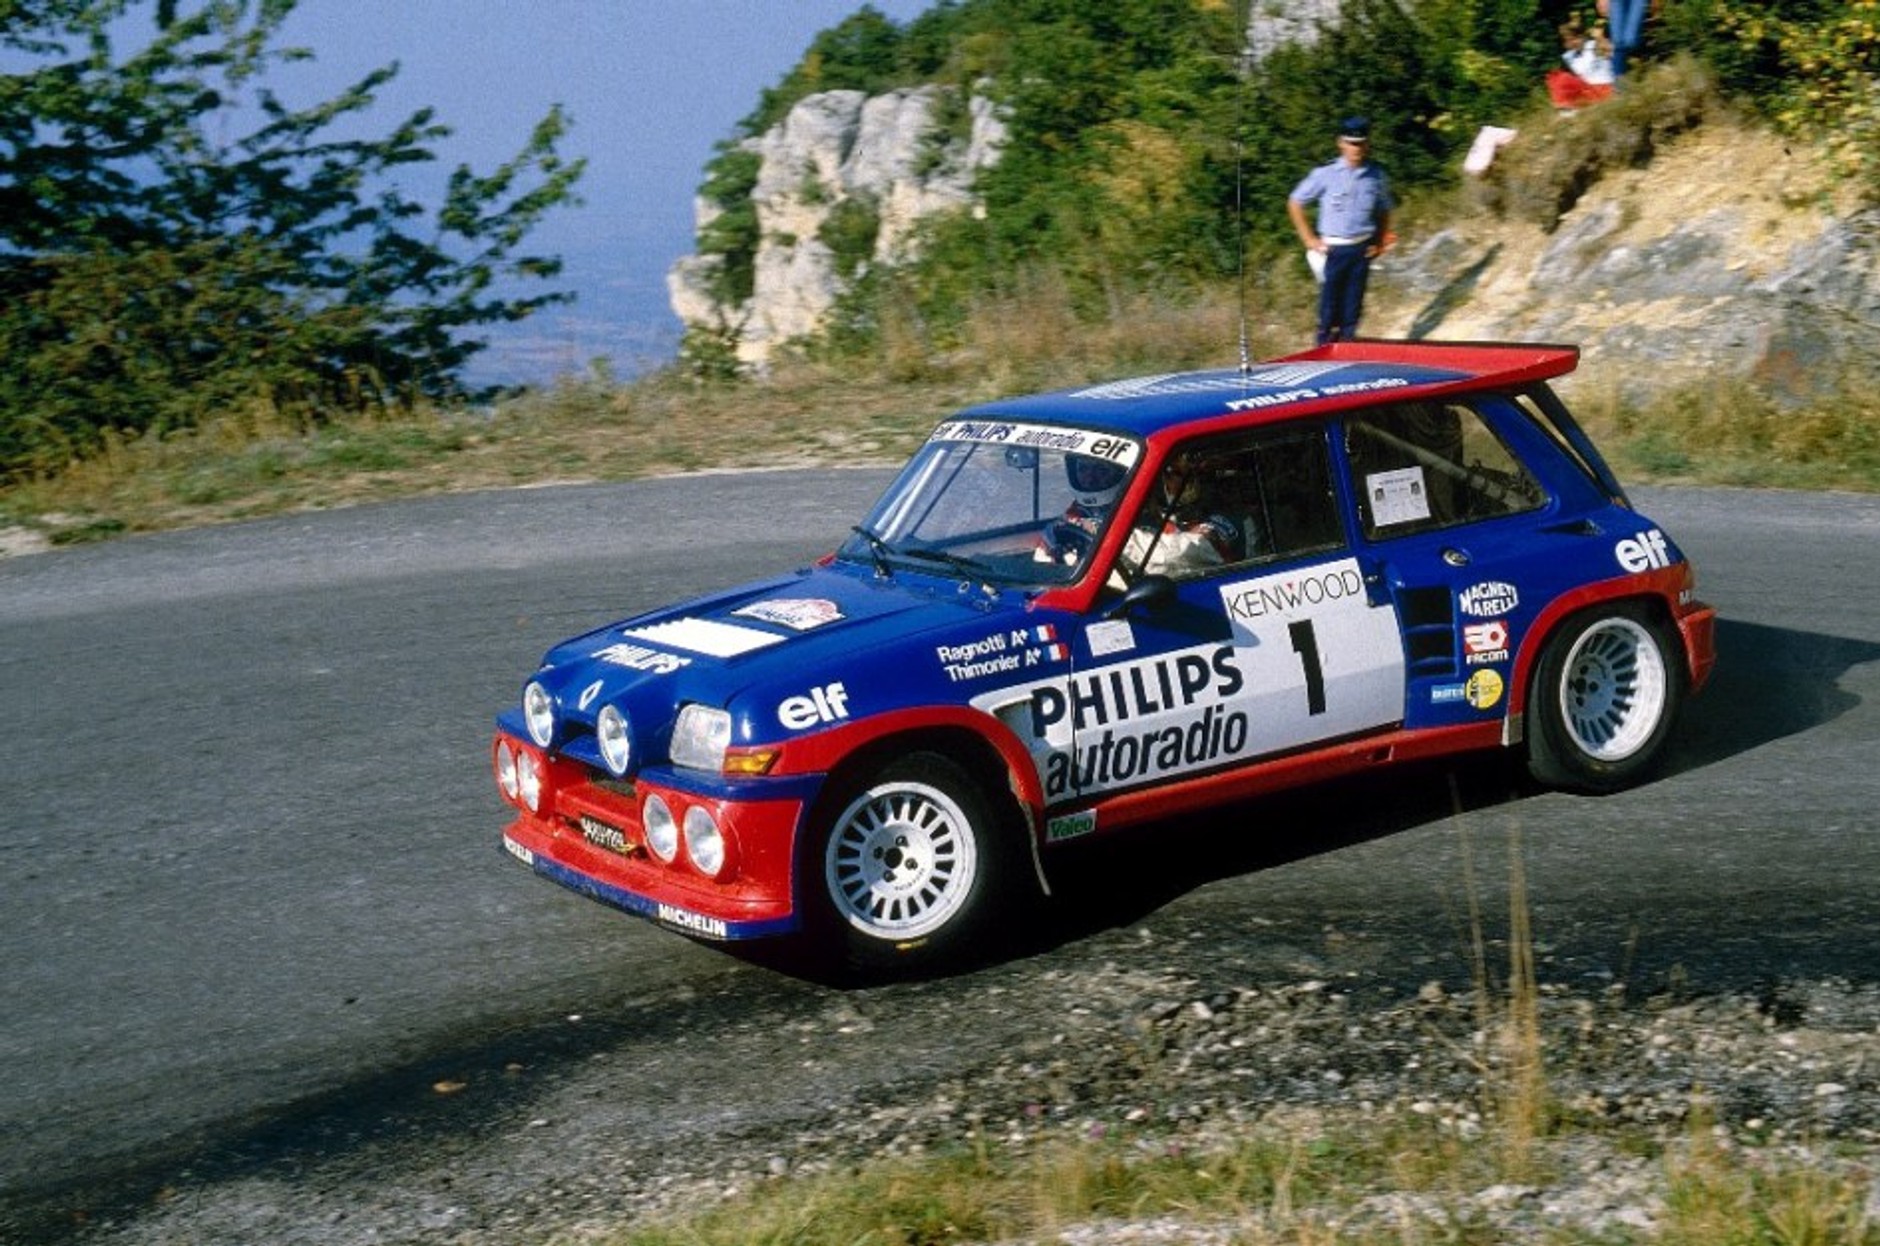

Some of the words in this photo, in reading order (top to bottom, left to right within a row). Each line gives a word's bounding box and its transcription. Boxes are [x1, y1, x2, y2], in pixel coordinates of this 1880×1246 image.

[1225, 388, 1318, 411] PHILIPS
[953, 423, 1016, 442] PHILIPS
[1015, 428, 1085, 449] autoradio
[1090, 438, 1132, 460] elf
[1615, 529, 1671, 573] elf
[1226, 568, 1362, 618] KENWOOD
[591, 643, 692, 674] PHILIPS
[936, 633, 1006, 664] Ragnotti
[944, 654, 1020, 682] Thimonier
[1288, 619, 1326, 716] 1
[778, 682, 849, 730] elf
[1031, 646, 1243, 738] PHILIPS
[1046, 707, 1248, 792] autoradio
[1051, 816, 1093, 838] Valeo
[659, 903, 727, 937] MICHELIN
